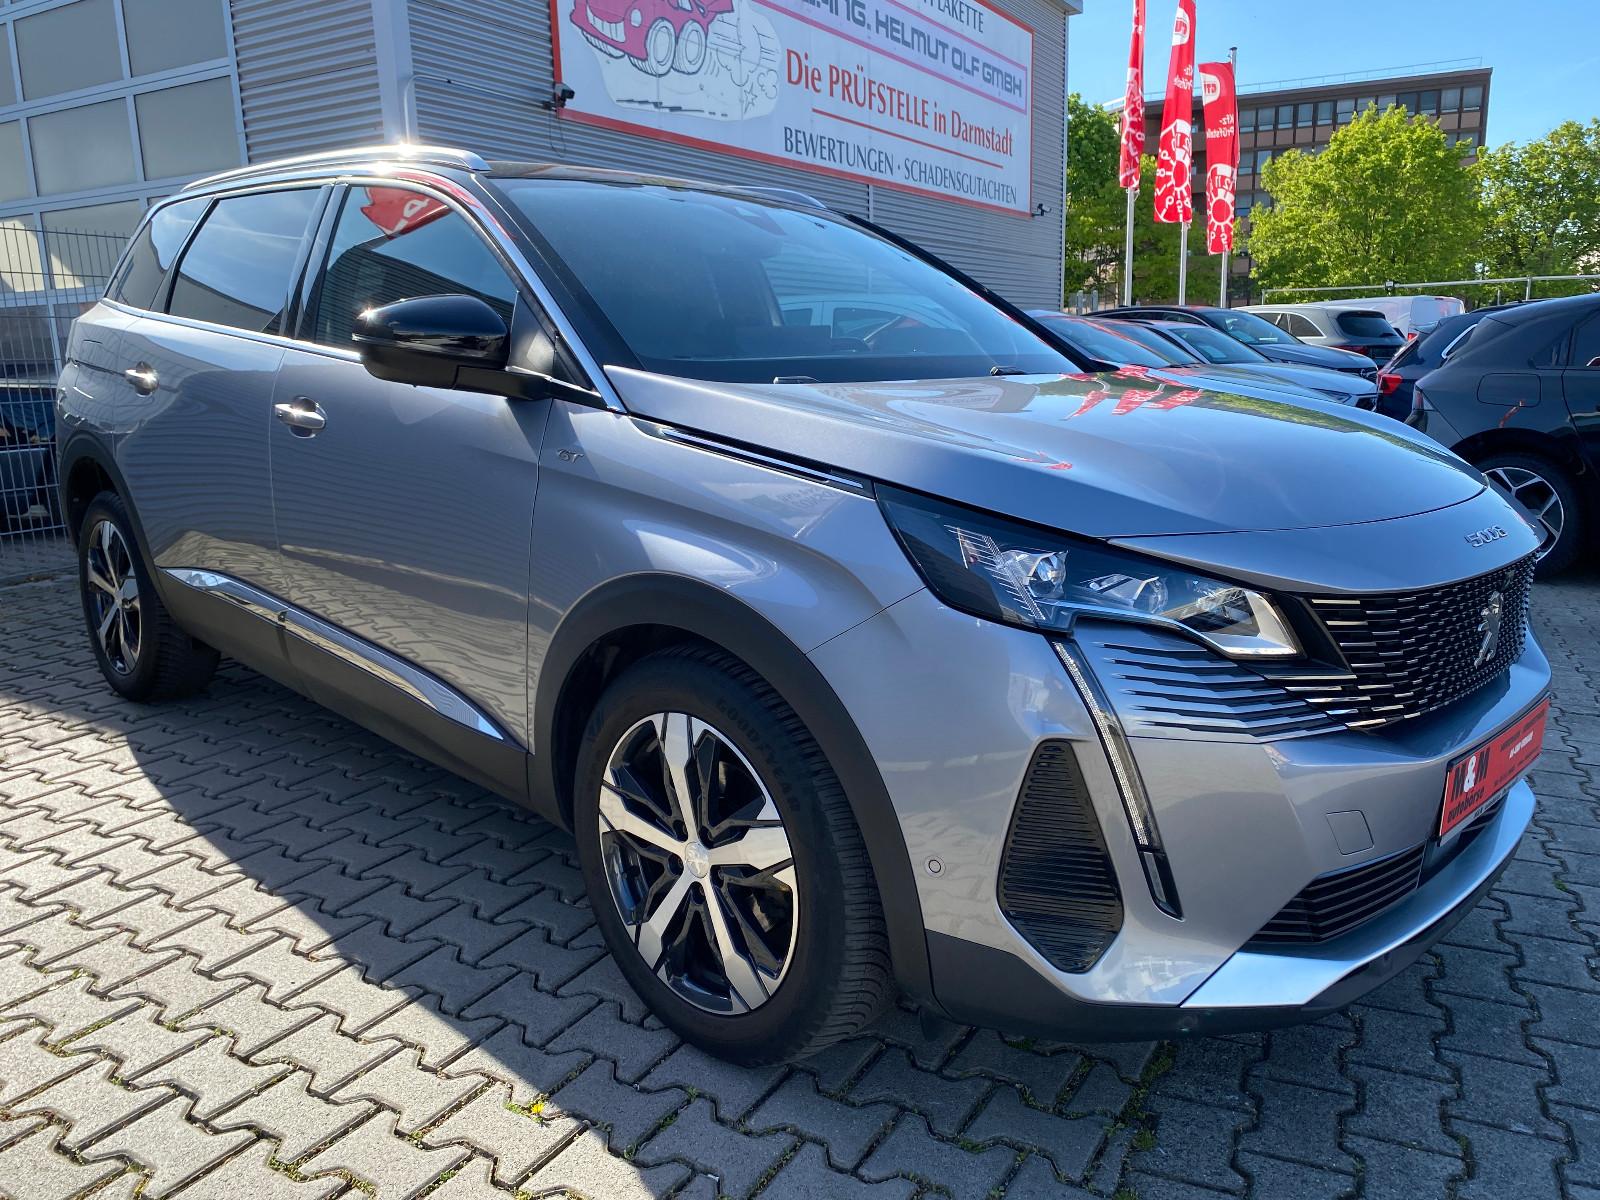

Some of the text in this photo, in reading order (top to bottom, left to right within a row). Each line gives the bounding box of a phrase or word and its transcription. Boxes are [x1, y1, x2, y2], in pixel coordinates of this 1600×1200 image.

[876, 9, 949, 64] HELMUT
[952, 46, 980, 76] OLF
[982, 62, 1022, 97] GMBH
[786, 48, 1013, 157] Die PRÜFSTELLE in Darmstadt
[784, 126, 1017, 204] BEWERTUNGEN SCHADENSGUTACHTEN
[557, 449, 585, 464] GT
